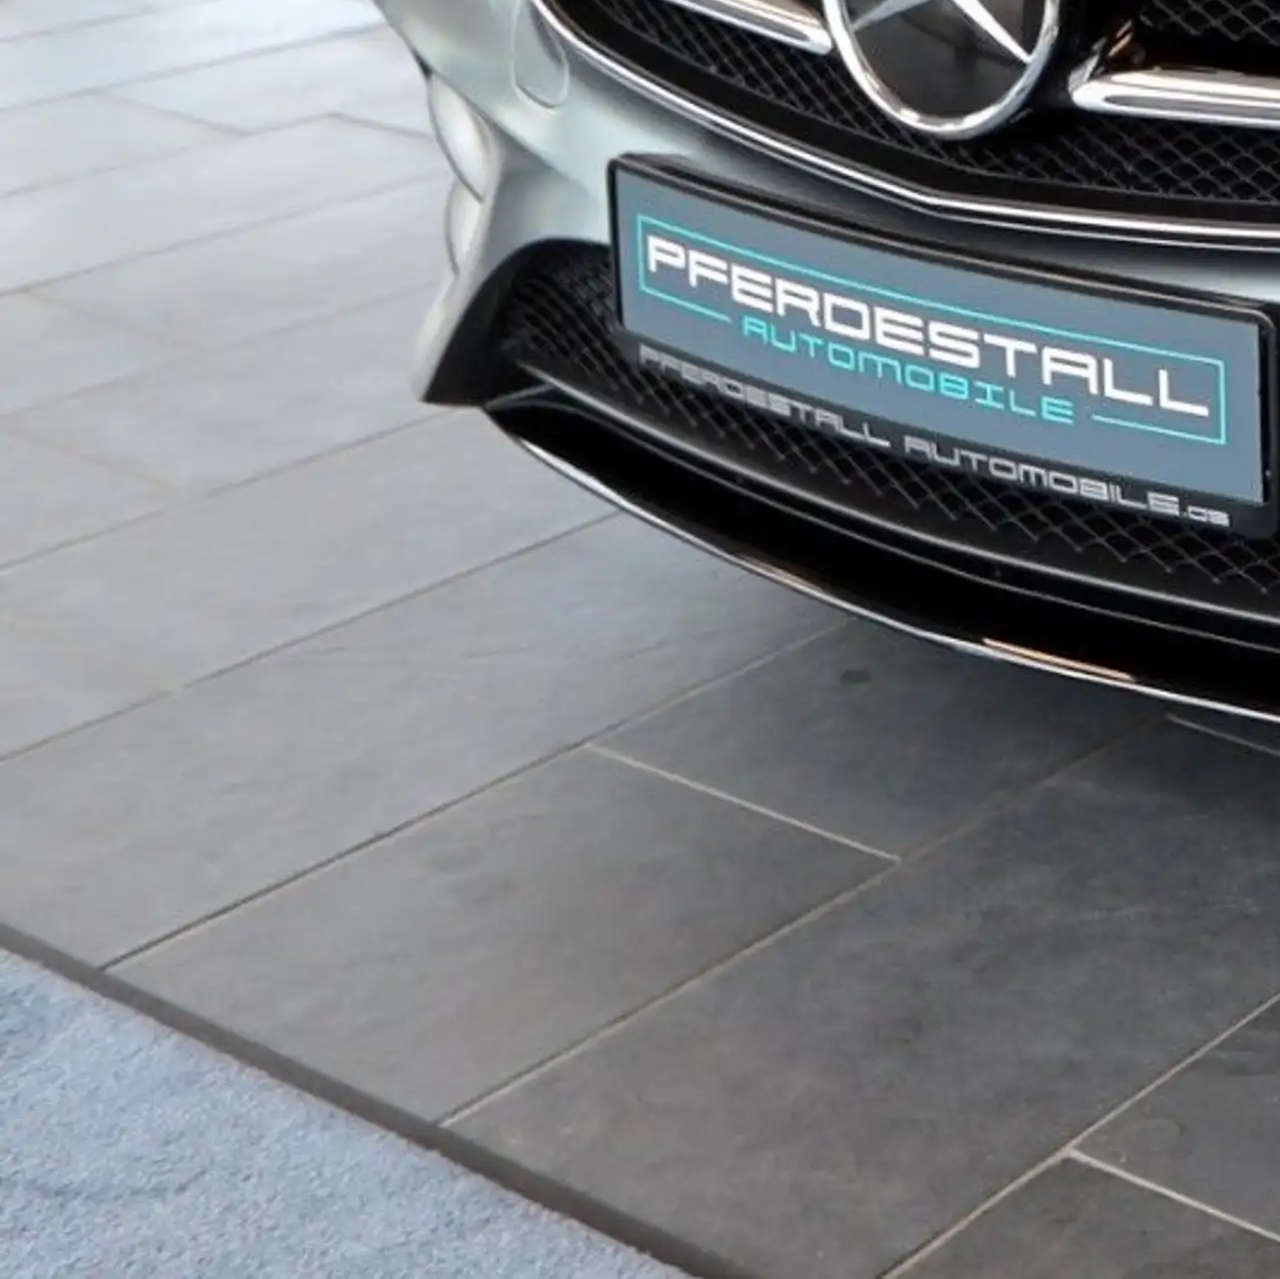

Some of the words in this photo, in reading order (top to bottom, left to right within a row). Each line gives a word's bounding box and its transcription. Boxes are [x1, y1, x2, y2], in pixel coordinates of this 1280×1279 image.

[646, 234, 1209, 417] PFERDESTALL
[741, 315, 1074, 425] AUTOMOBILE
[638, 343, 891, 448] PFERDESTALL
